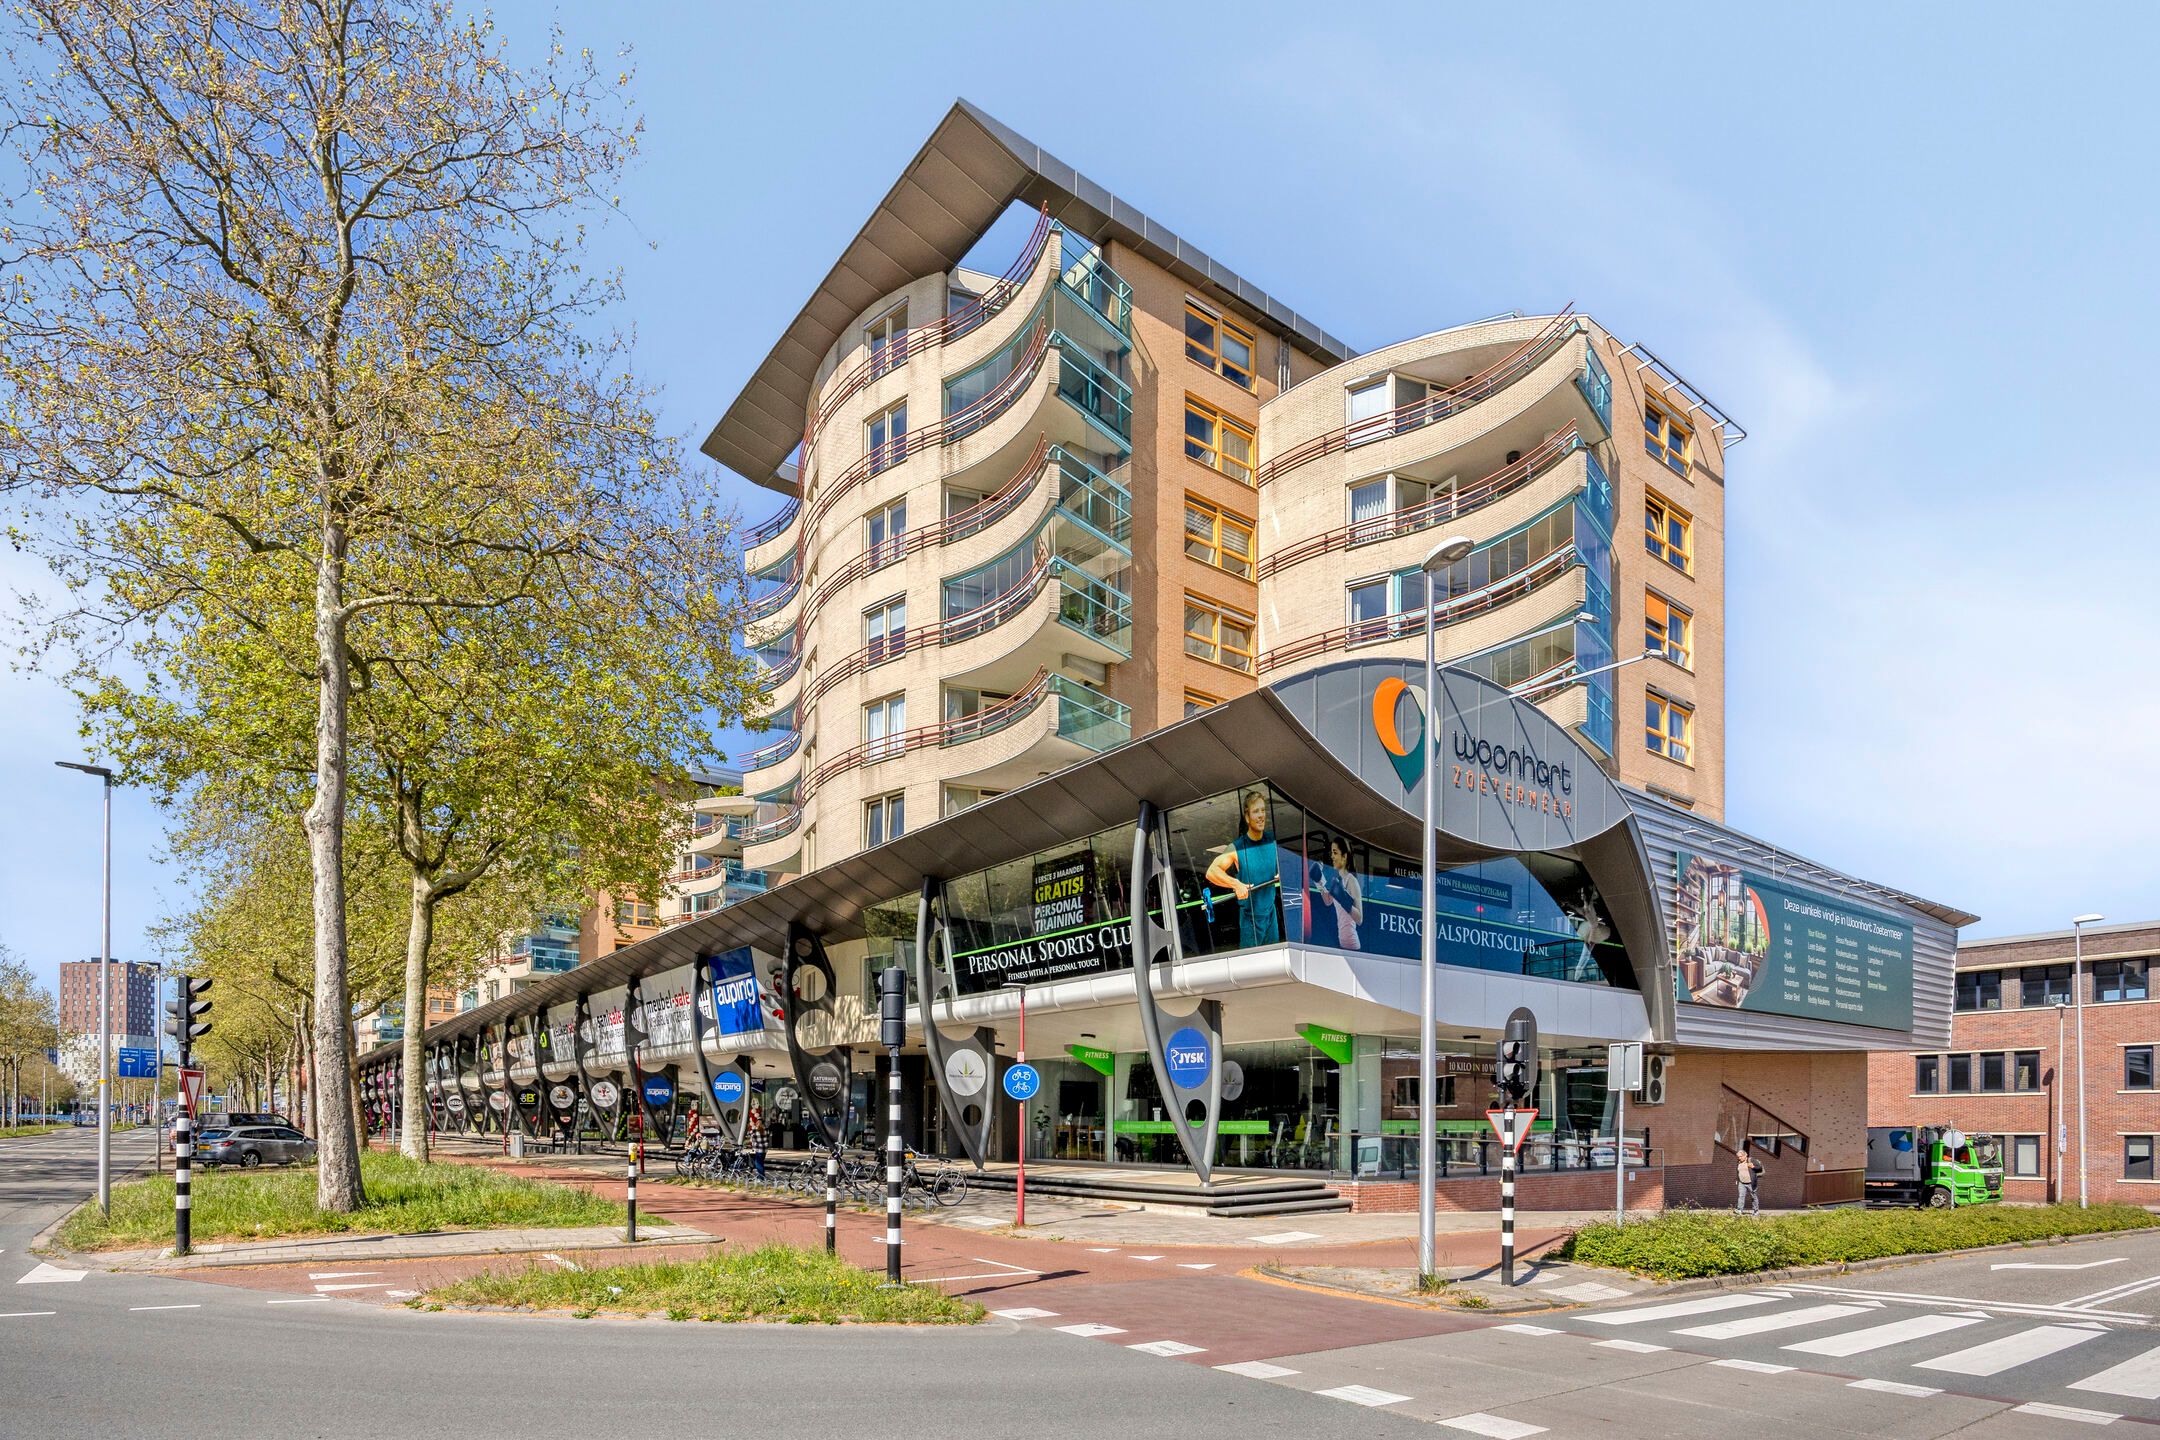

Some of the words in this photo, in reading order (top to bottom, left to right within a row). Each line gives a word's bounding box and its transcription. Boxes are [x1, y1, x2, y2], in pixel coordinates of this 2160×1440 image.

[1453, 730, 1571, 792] woonhart
[1453, 765, 1572, 817] ZOETERMEER
[1057, 863, 1085, 879] MAANDEN
[1035, 875, 1084, 904] GRATIS!
[1035, 896, 1084, 920] PERSONAL
[1784, 898, 1800, 913] Deze
[1800, 903, 1822, 919] winkels
[1822, 909, 1835, 922] vind
[1834, 912, 1840, 926] je
[1840, 913, 1846, 926] in
[1872, 923, 1904, 940] Zoetermeer
[1034, 909, 1084, 933] TRAINING
[1380, 912, 1550, 957] PERSOALSPORTSCLUB.NL
[968, 946, 1037, 975] PERSONAL
[1039, 933, 1095, 962] SPORTS
[1098, 925, 1134, 950] CLU
[1007, 970, 1028, 981] FITNESS
[1028, 967, 1044, 978] WITH
[1049, 962, 1078, 975] PERSONAL
[1077, 958, 1100, 970] TOUCH
[717, 977, 756, 1009] auping
[1321, 1033, 1348, 1043] FITNESS
[1085, 1051, 1110, 1059] FITNESS
[1179, 1052, 1205, 1064] JYSK
[1456, 1061, 1472, 1072] KILO
[1472, 1063, 1480, 1072] IN
[646, 1088, 670, 1097] auping
[715, 1081, 742, 1092] auping
